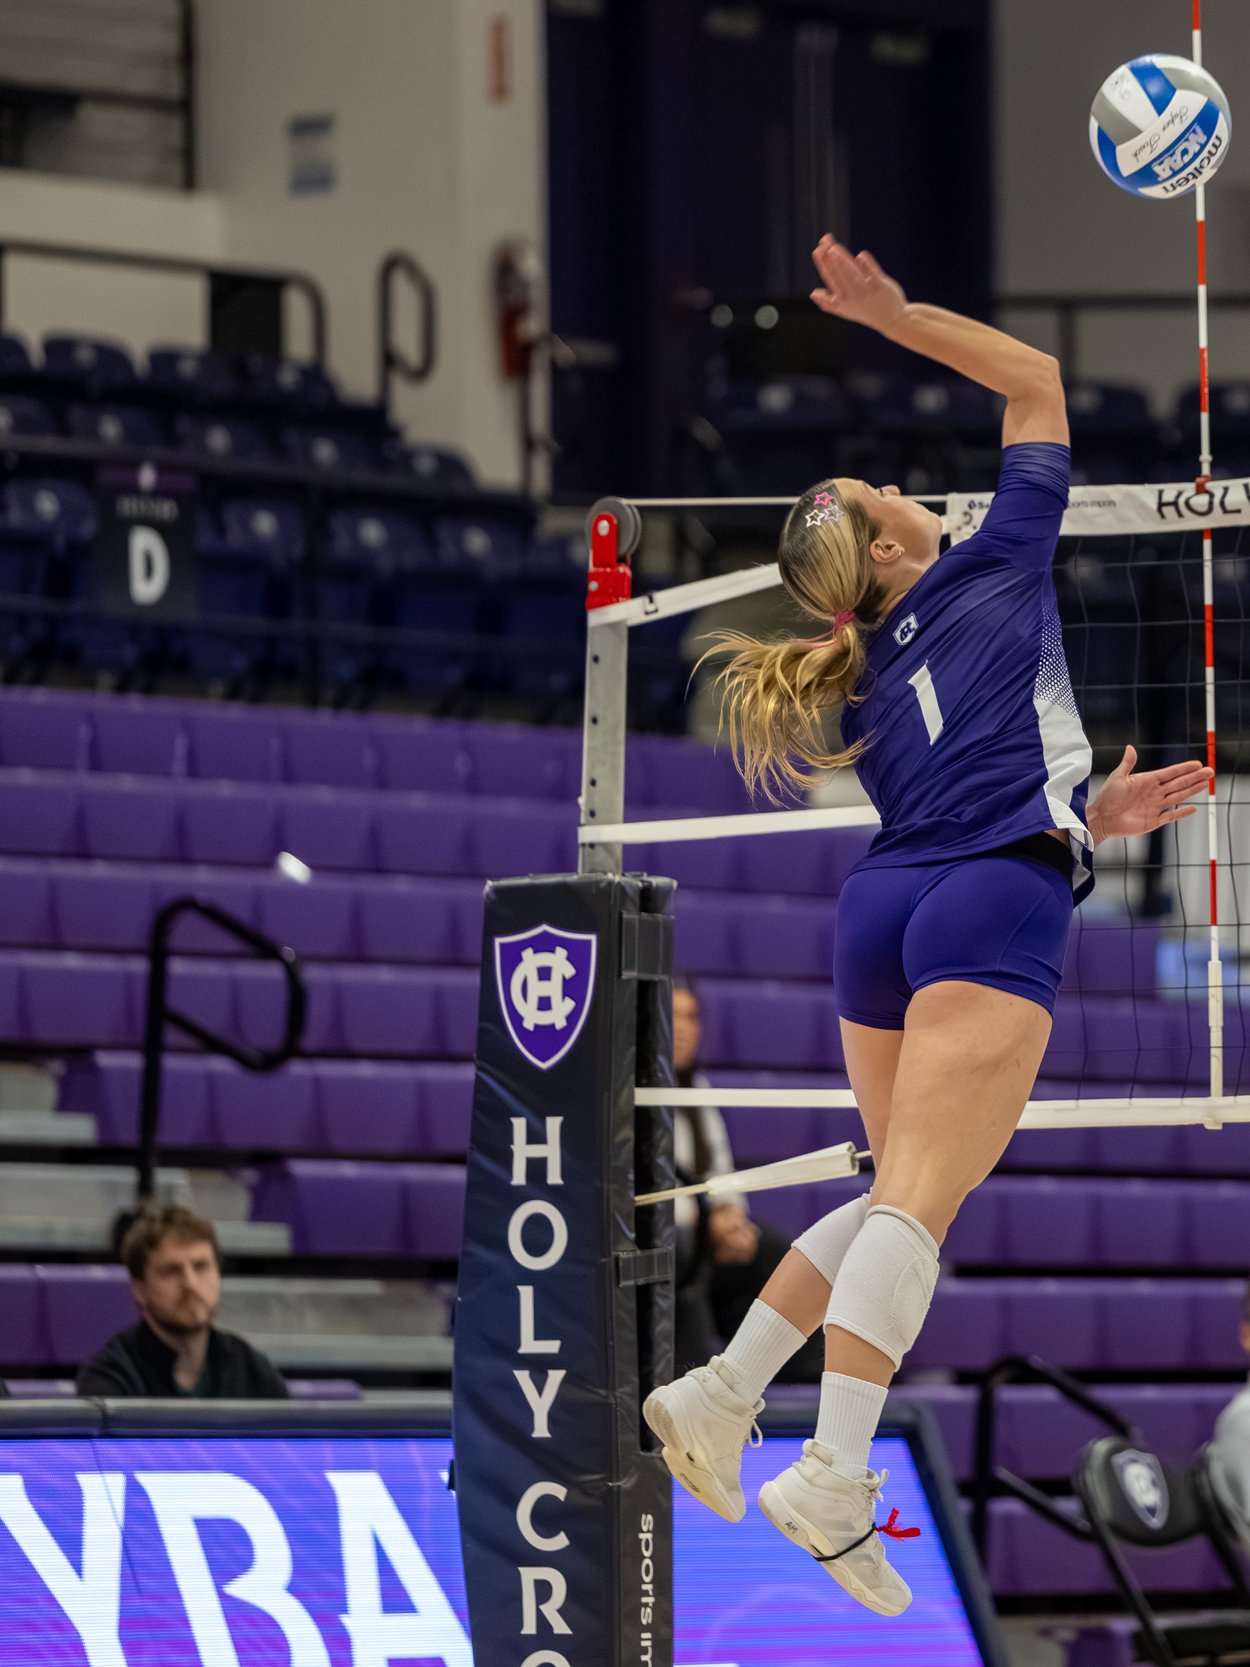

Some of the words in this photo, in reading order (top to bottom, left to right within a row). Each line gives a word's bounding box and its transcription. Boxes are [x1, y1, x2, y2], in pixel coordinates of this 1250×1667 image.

[1152, 122, 1207, 182] NCAA
[1162, 134, 1222, 194] molten
[128, 524, 171, 606] D
[907, 662, 944, 747] 1
[507, 1116, 569, 1438] HOLY
[516, 1480, 573, 1667] CR
[637, 1513, 655, 1626] sports
